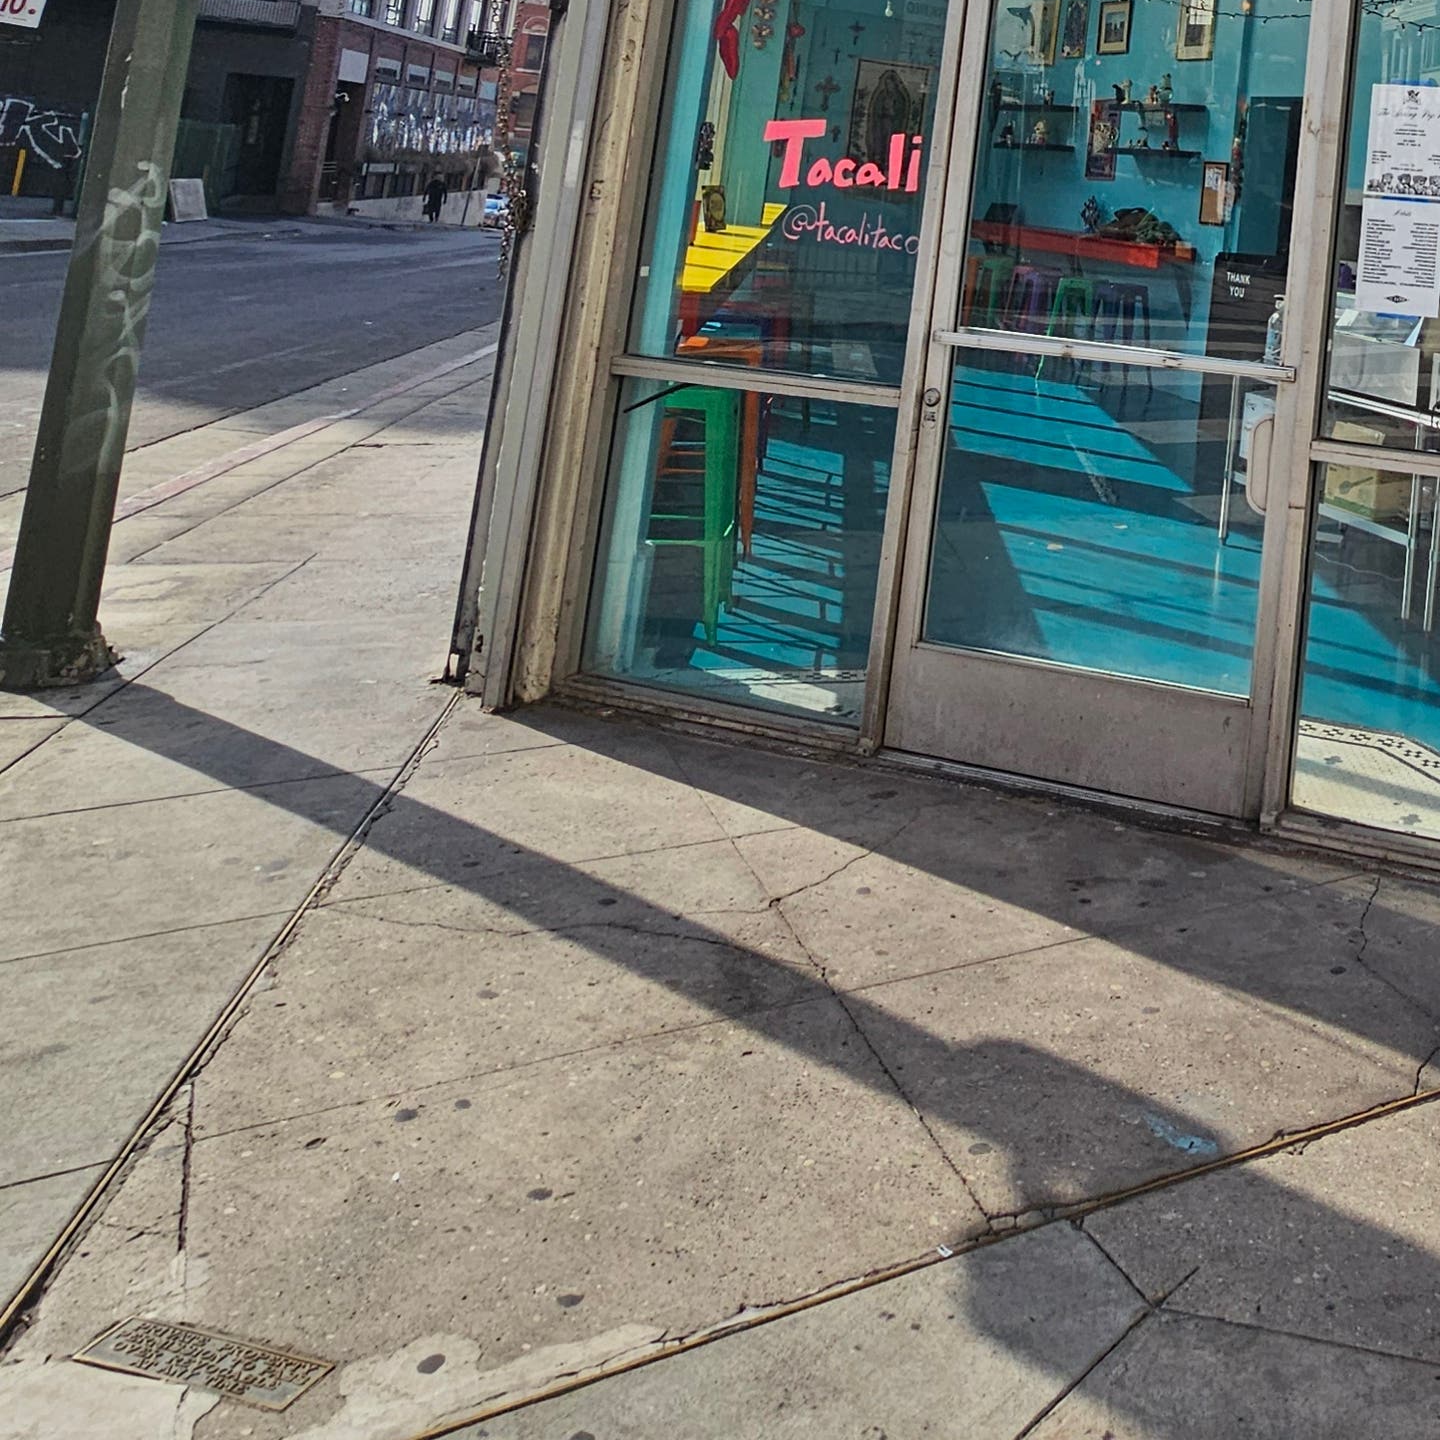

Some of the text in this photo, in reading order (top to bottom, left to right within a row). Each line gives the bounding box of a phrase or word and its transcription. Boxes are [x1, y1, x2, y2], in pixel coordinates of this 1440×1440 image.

[763, 119, 923, 192] Tacali
[1227, 271, 1250, 285] THANK
[1230, 285, 1245, 298] YOU
[217, 1344, 319, 1375] PROPERTY
